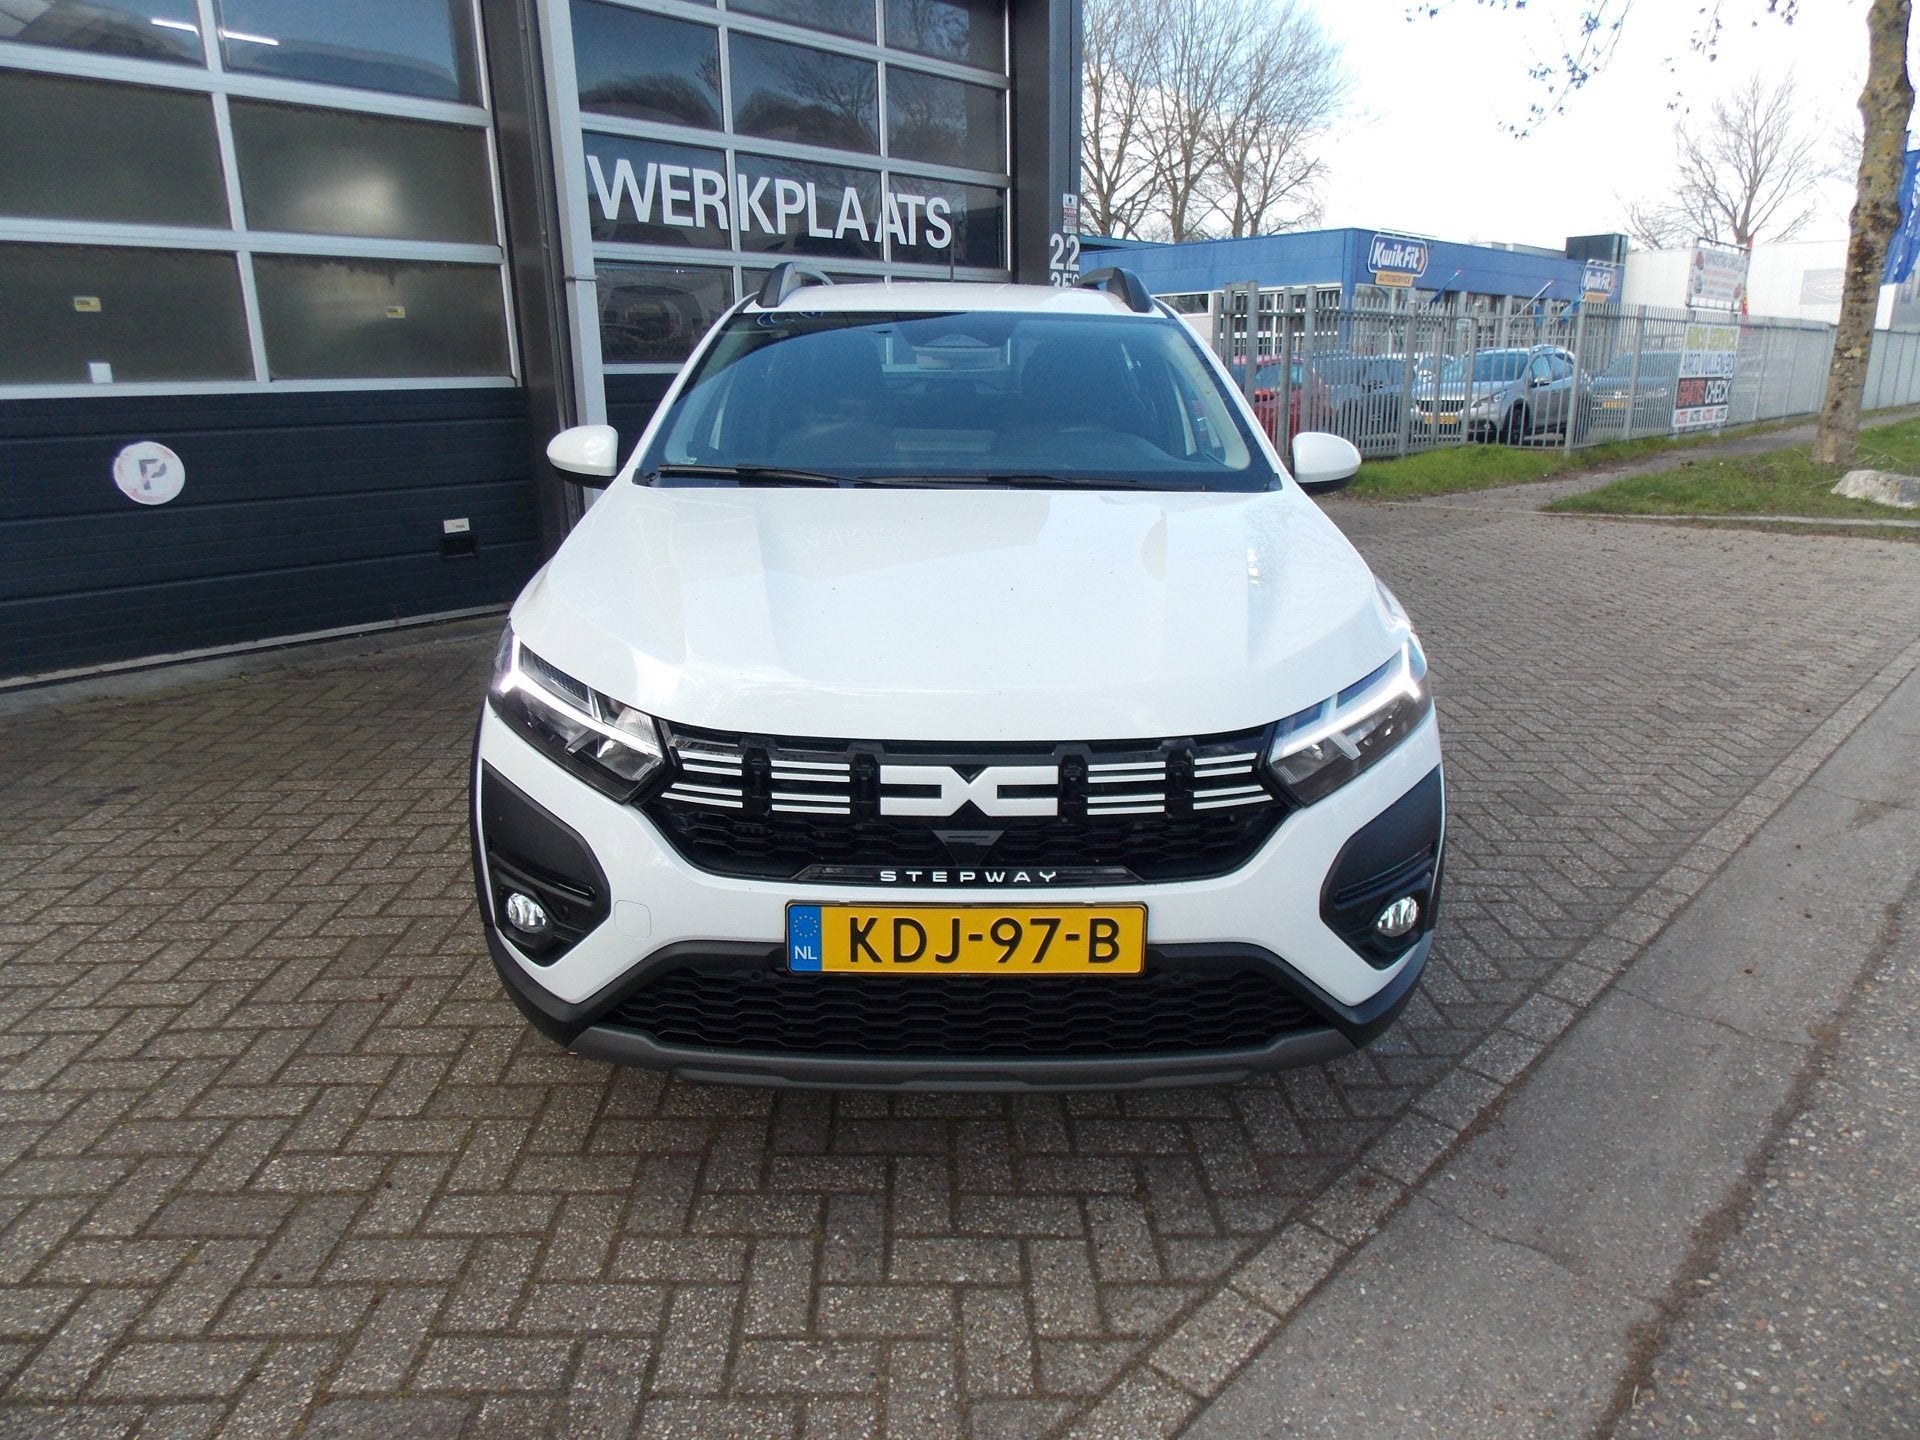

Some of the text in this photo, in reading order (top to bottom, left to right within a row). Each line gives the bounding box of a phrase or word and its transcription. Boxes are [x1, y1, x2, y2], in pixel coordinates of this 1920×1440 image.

[587, 155, 951, 249] WERKPLAATS
[1050, 233, 1080, 271] 22
[1705, 379, 1731, 404] CHECK
[879, 870, 1059, 884] STEPWAY
[794, 946, 818, 961] NL
[848, 916, 1121, 965] KDJ-97-B
